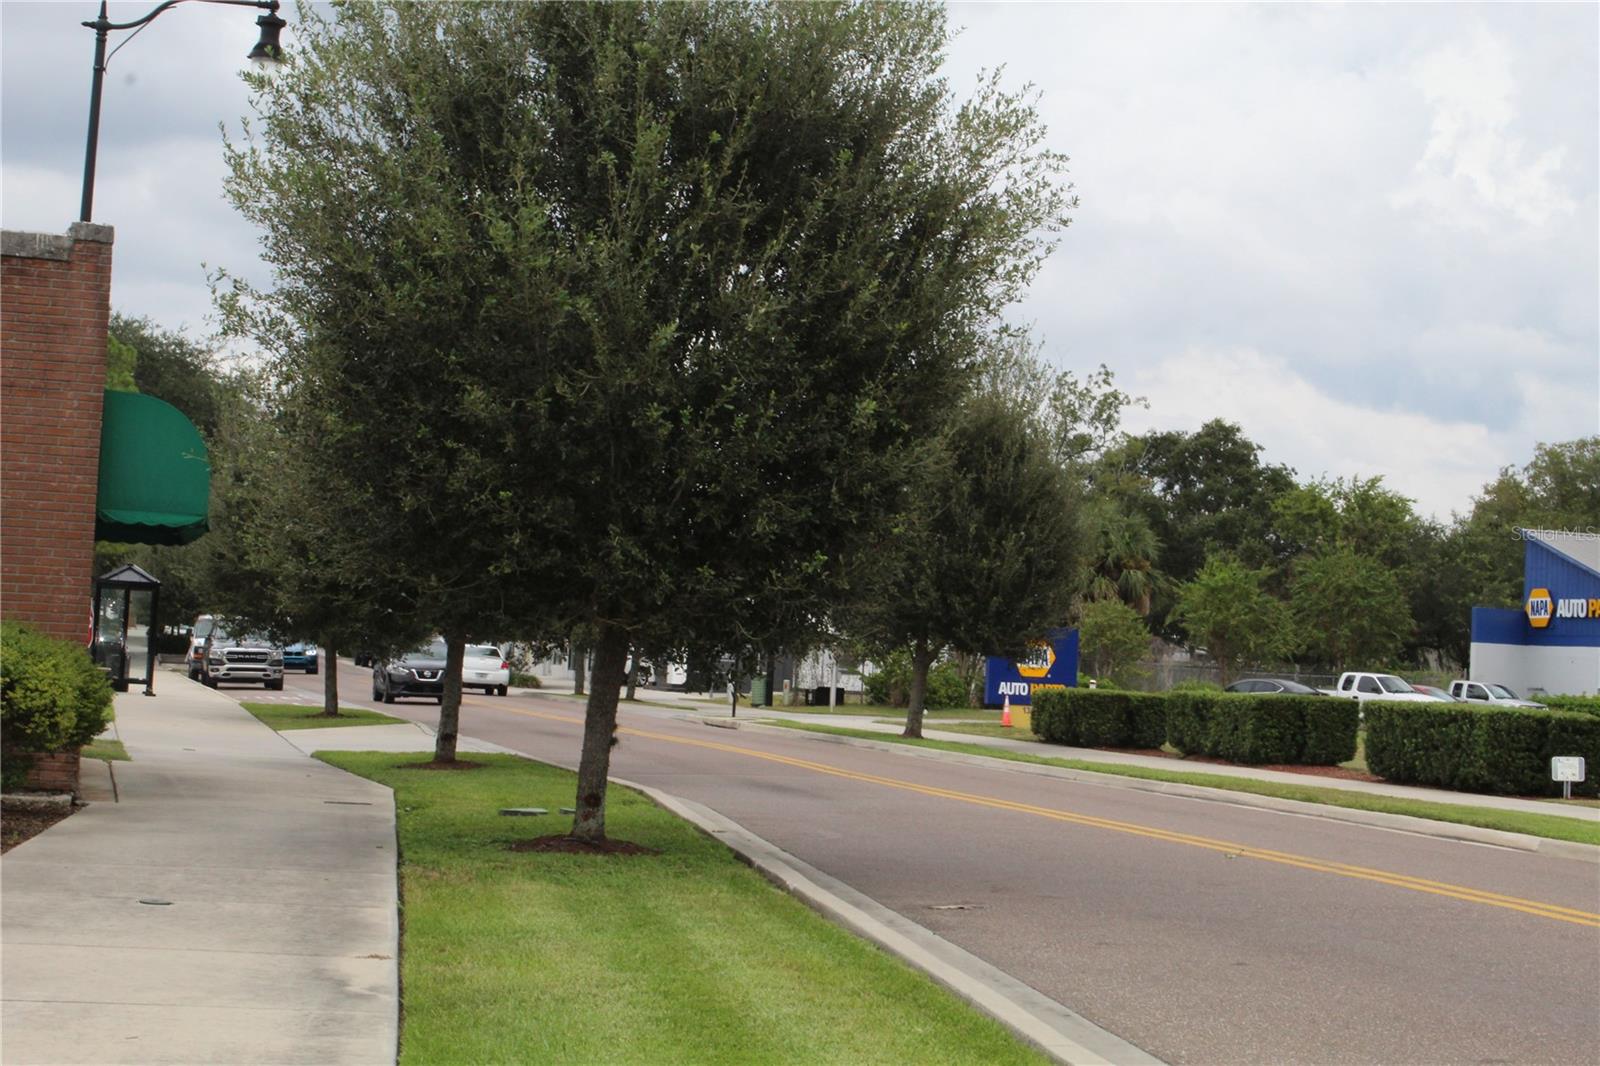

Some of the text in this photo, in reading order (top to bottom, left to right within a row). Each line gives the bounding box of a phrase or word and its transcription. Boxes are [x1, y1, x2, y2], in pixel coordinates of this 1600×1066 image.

[1530, 599, 1549, 617] NAPA
[1556, 598, 1587, 618] AUTO
[998, 682, 1028, 696] AUTO
